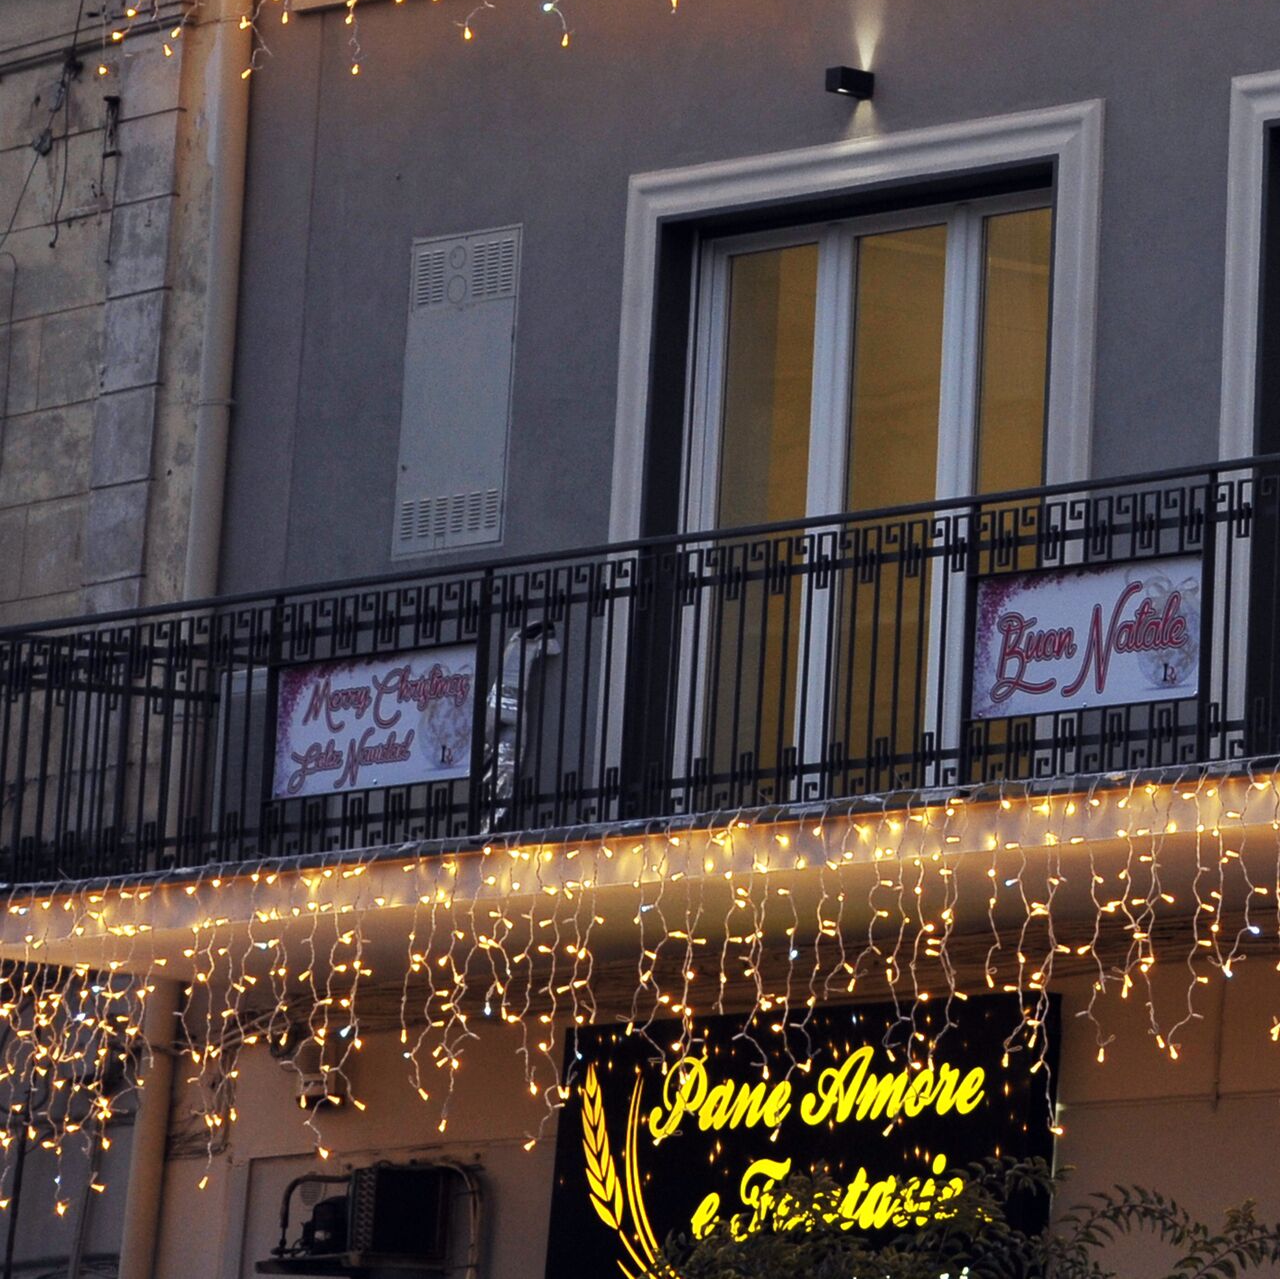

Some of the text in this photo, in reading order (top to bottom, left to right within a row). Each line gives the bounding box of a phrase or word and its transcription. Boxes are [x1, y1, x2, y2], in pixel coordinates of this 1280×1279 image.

[991, 581, 1188, 702] Buon Natale
[303, 663, 471, 733] Merry Christmas
[288, 727, 415, 794] Feliz Navidad
[649, 1045, 986, 1139] Pane Amore
